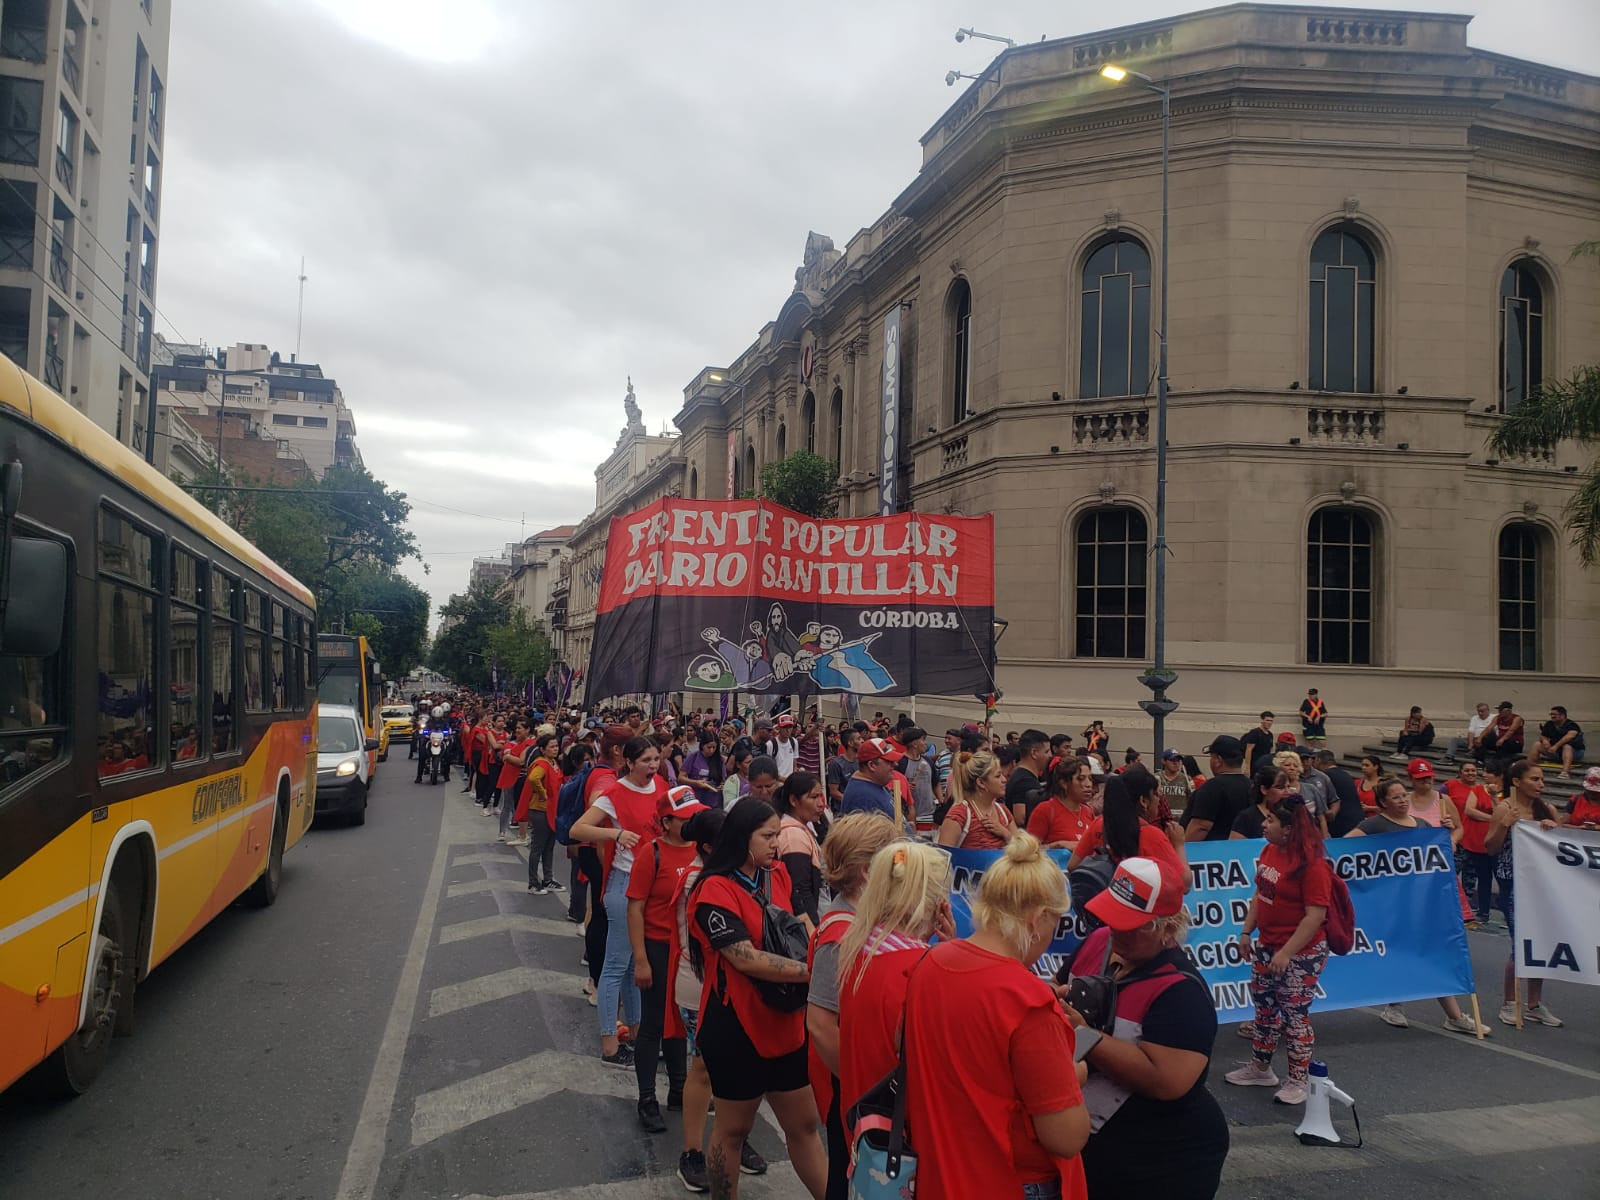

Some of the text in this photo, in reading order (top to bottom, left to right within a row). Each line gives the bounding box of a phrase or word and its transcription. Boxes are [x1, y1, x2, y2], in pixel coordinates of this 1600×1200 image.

[627, 508, 958, 557] FRENTE POPULAR
[622, 550, 960, 597] DARIO SANTILLAN
[858, 606, 960, 629] CÓRDOBA
[1523, 938, 1581, 972] LA
